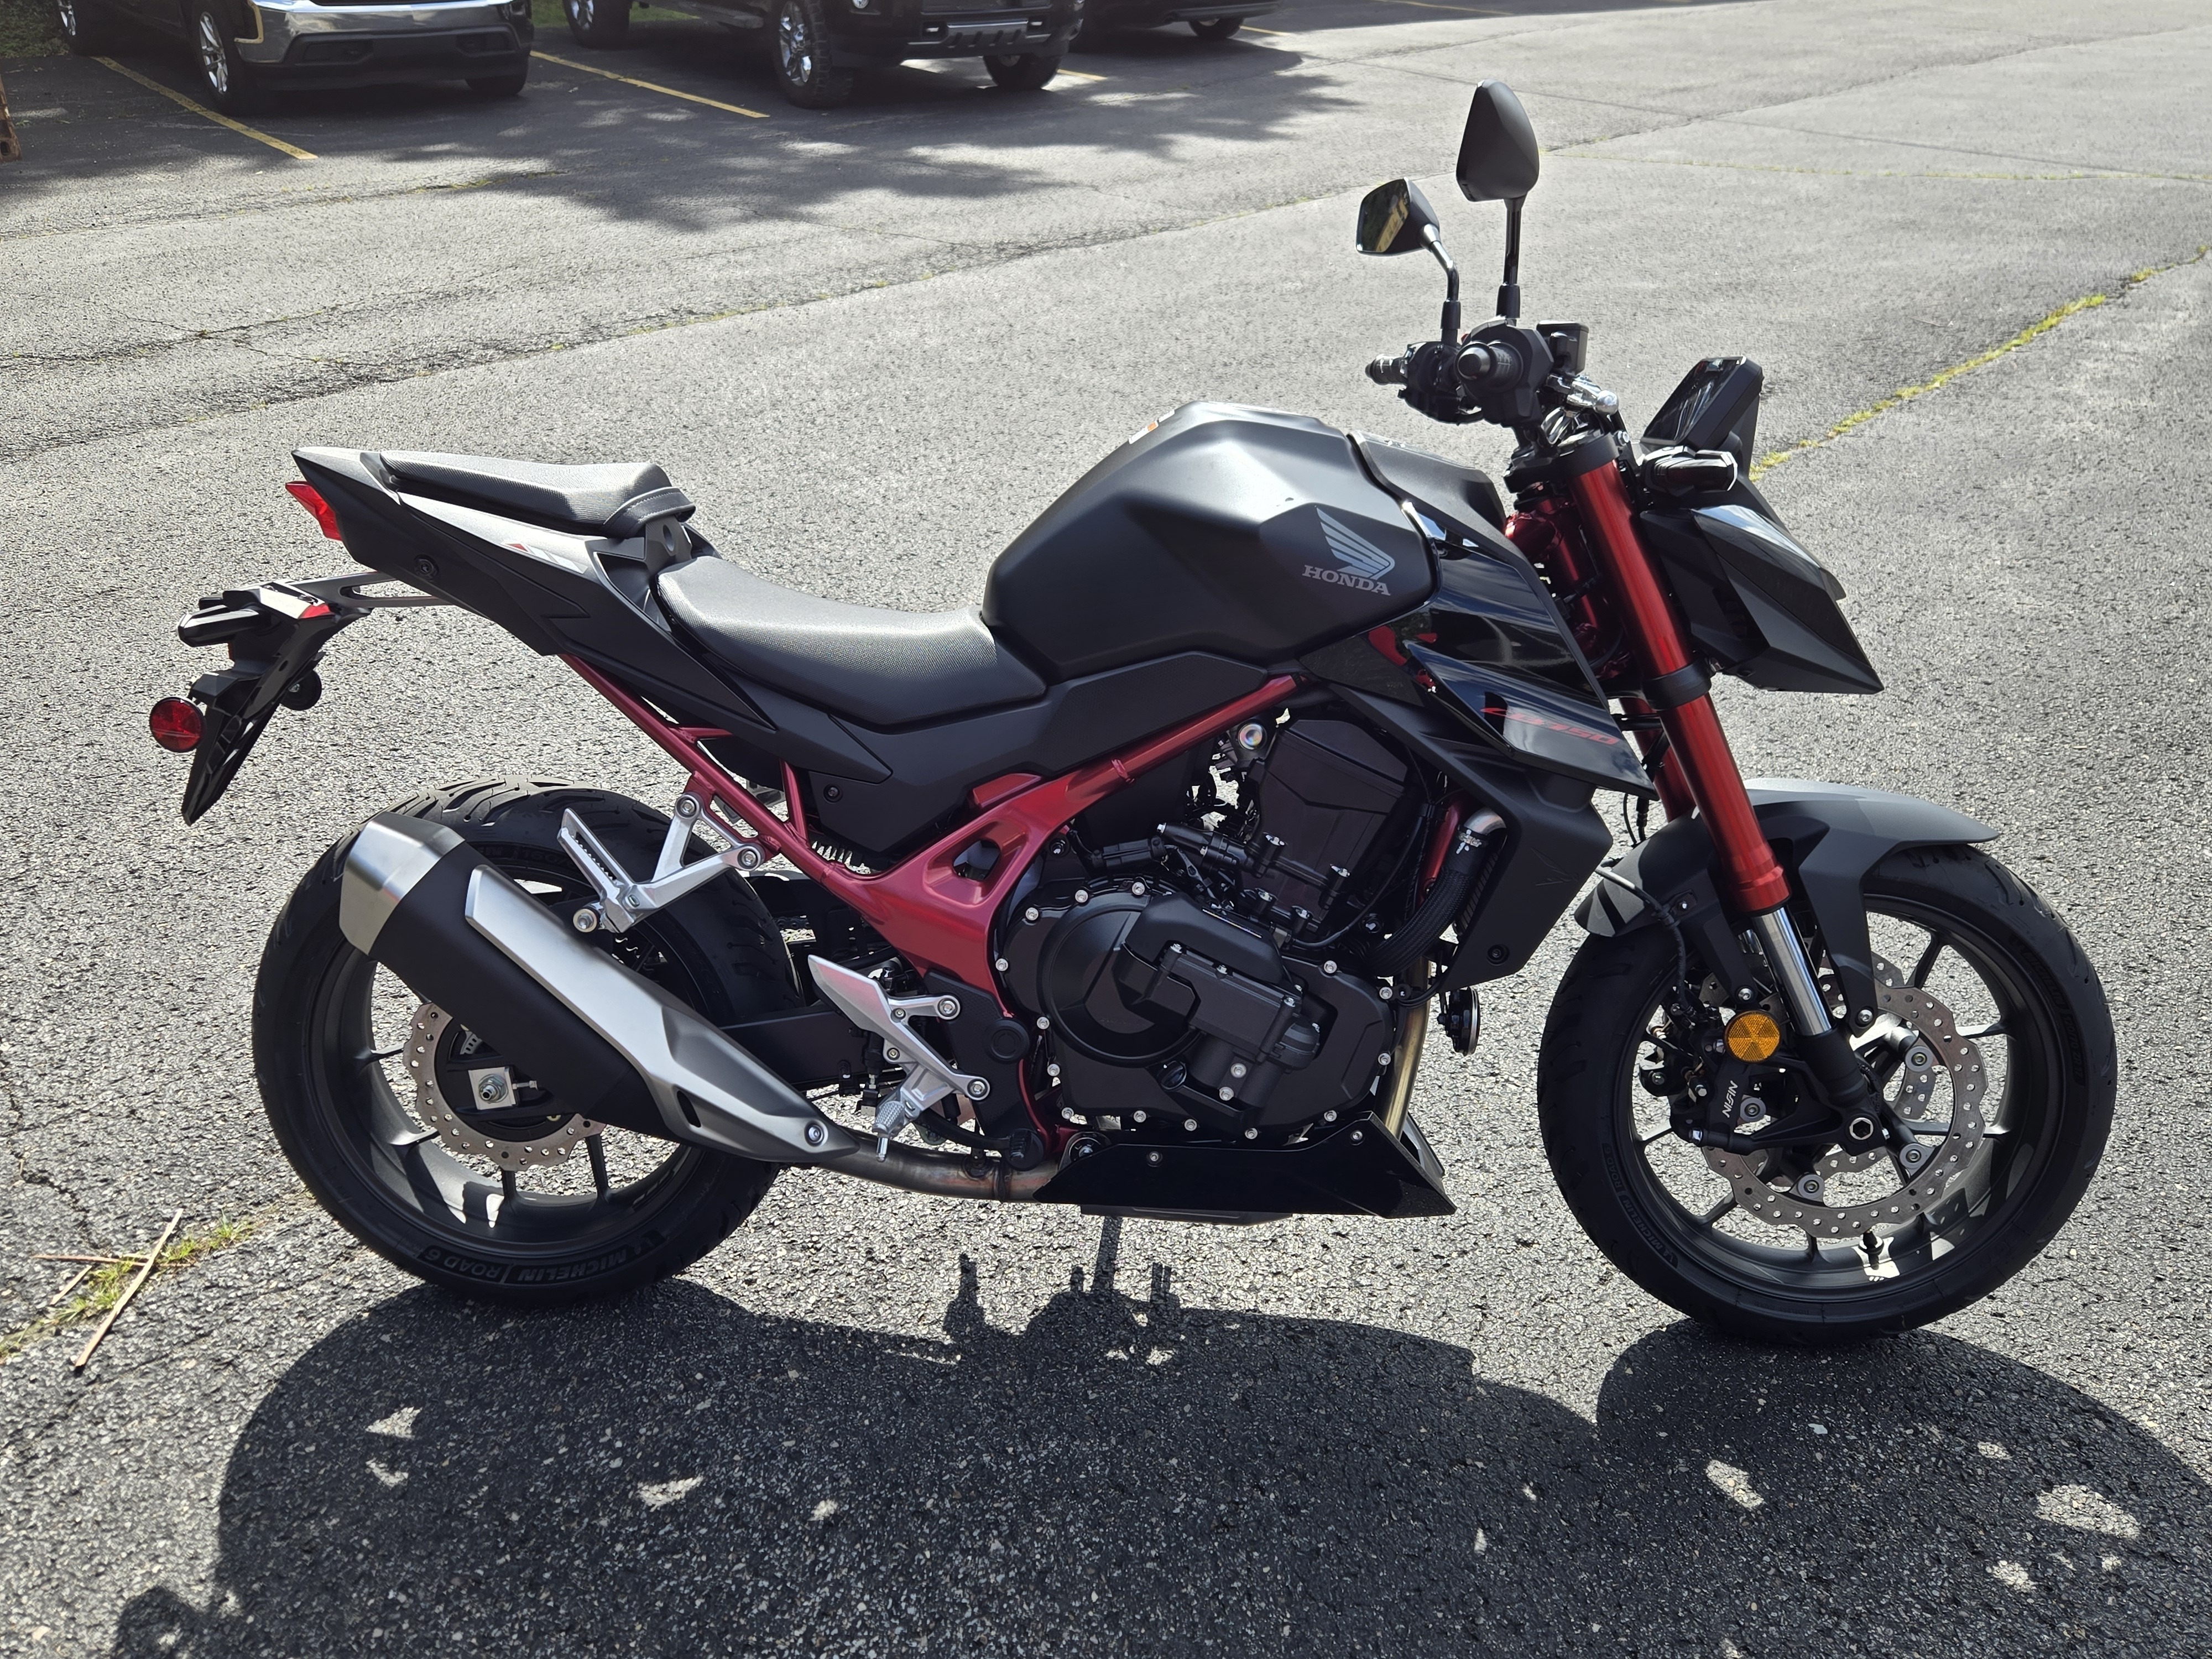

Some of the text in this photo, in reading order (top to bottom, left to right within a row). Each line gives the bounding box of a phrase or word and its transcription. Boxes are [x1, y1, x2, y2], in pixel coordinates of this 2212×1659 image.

[1302, 565, 1391, 596] HONDA
[1722, 1081, 1738, 1118] NISSIN
[1606, 1158, 1622, 1188] ROAD
[1623, 1199, 1663, 1253] MICHELIN
[425, 1248, 627, 1281] MICHELIN ROAD 6
